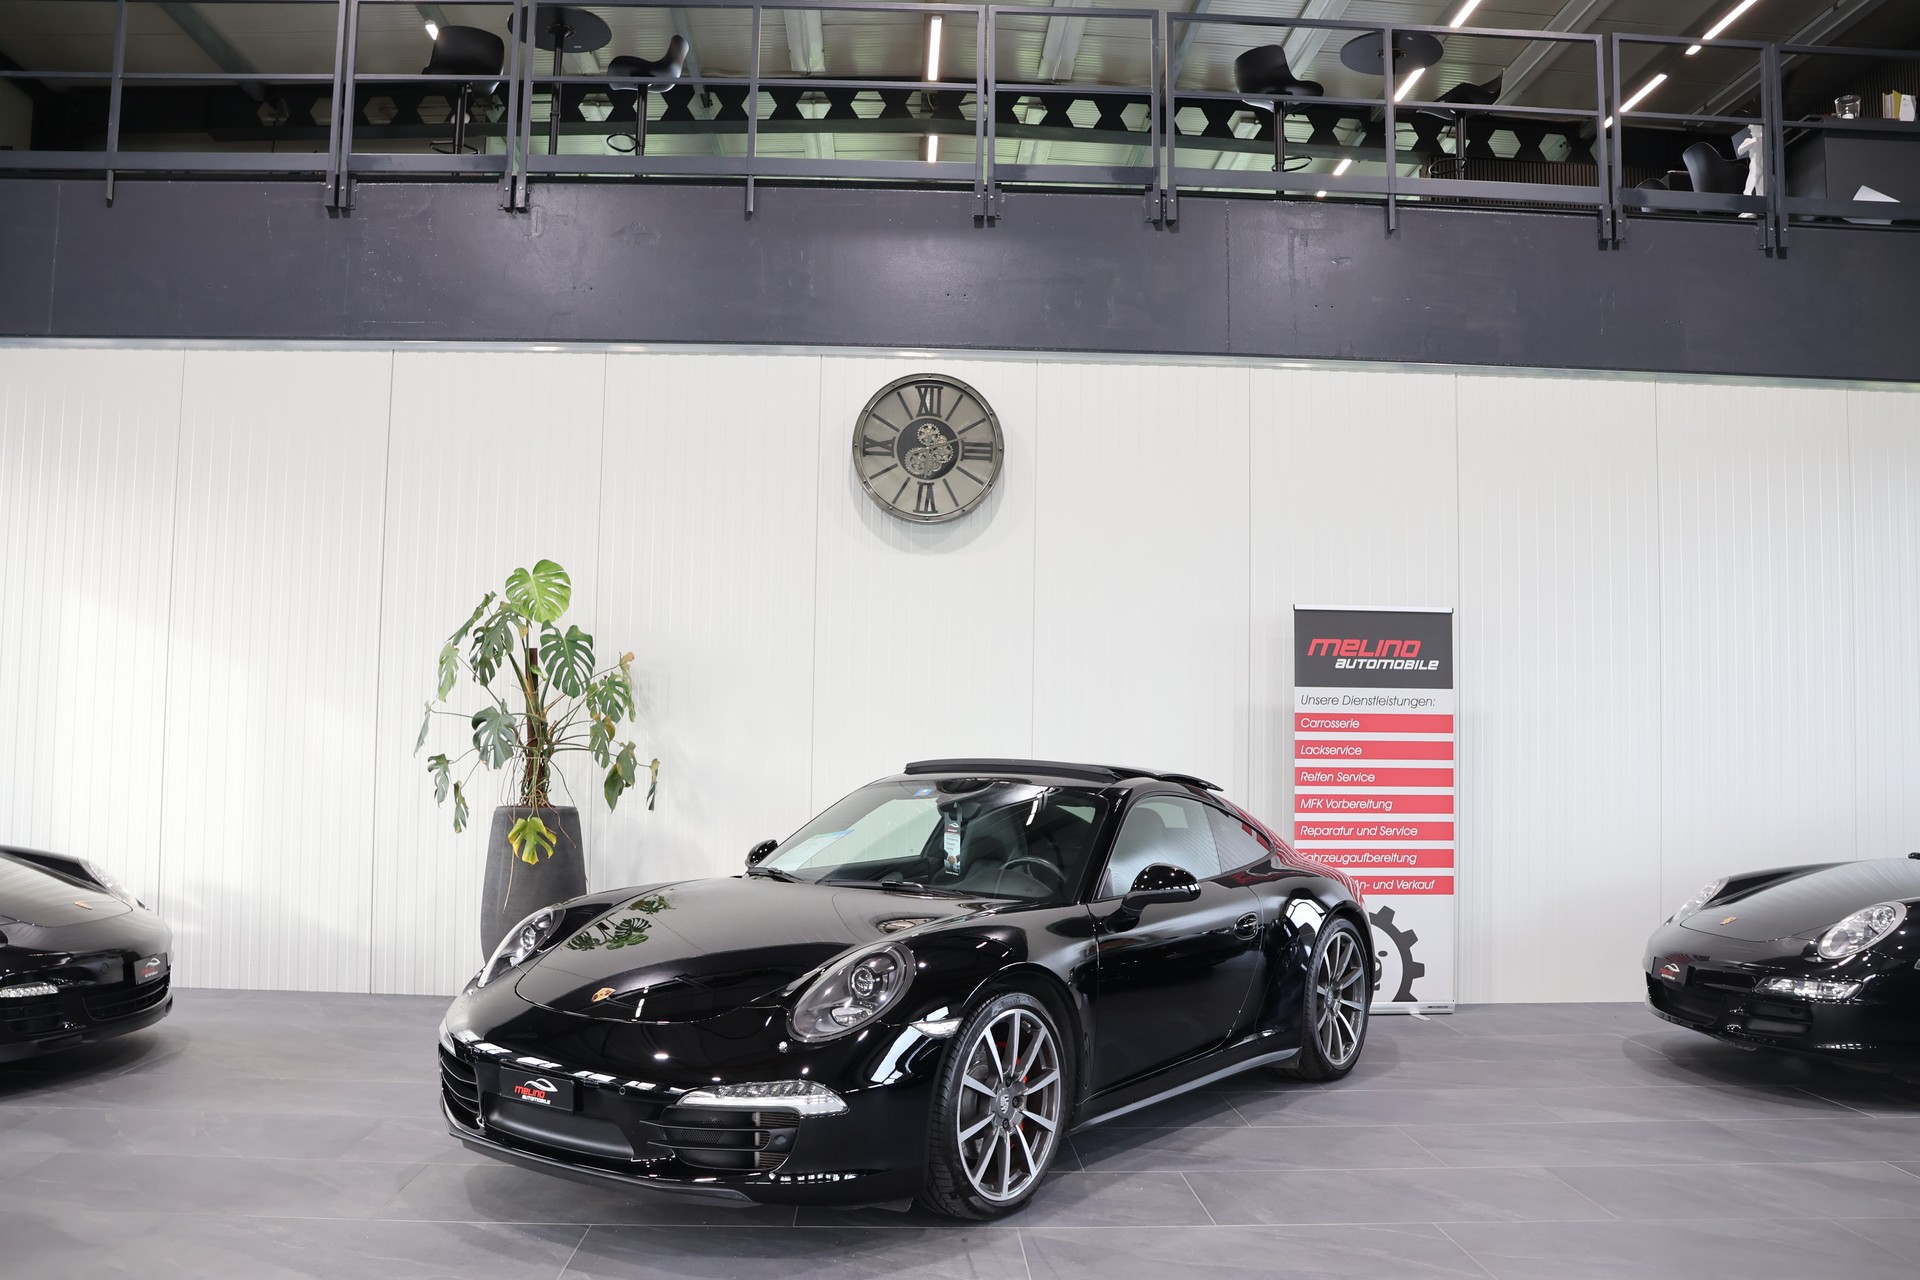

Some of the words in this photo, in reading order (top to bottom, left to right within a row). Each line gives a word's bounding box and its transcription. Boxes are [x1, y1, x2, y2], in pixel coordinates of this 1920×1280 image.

[915, 385, 944, 418] XII
[960, 440, 993, 463] III
[1300, 694, 1339, 706] Unsere
[1342, 695, 1436, 709] Dienstleistungen:
[1300, 718, 1360, 729] Carrosserie
[1300, 745, 1363, 756] Lackservice
[1300, 771, 1334, 783] Reifen
[1336, 771, 1376, 783] Service
[1300, 798, 1323, 809] MFK
[1325, 799, 1393, 812] Vorbereitung
[1300, 826, 1354, 838] Reparatur
[1356, 826, 1377, 836] und
[1379, 826, 1418, 836] Service
[1373, 879, 1394, 890] und
[1396, 879, 1435, 890] Verkauf
